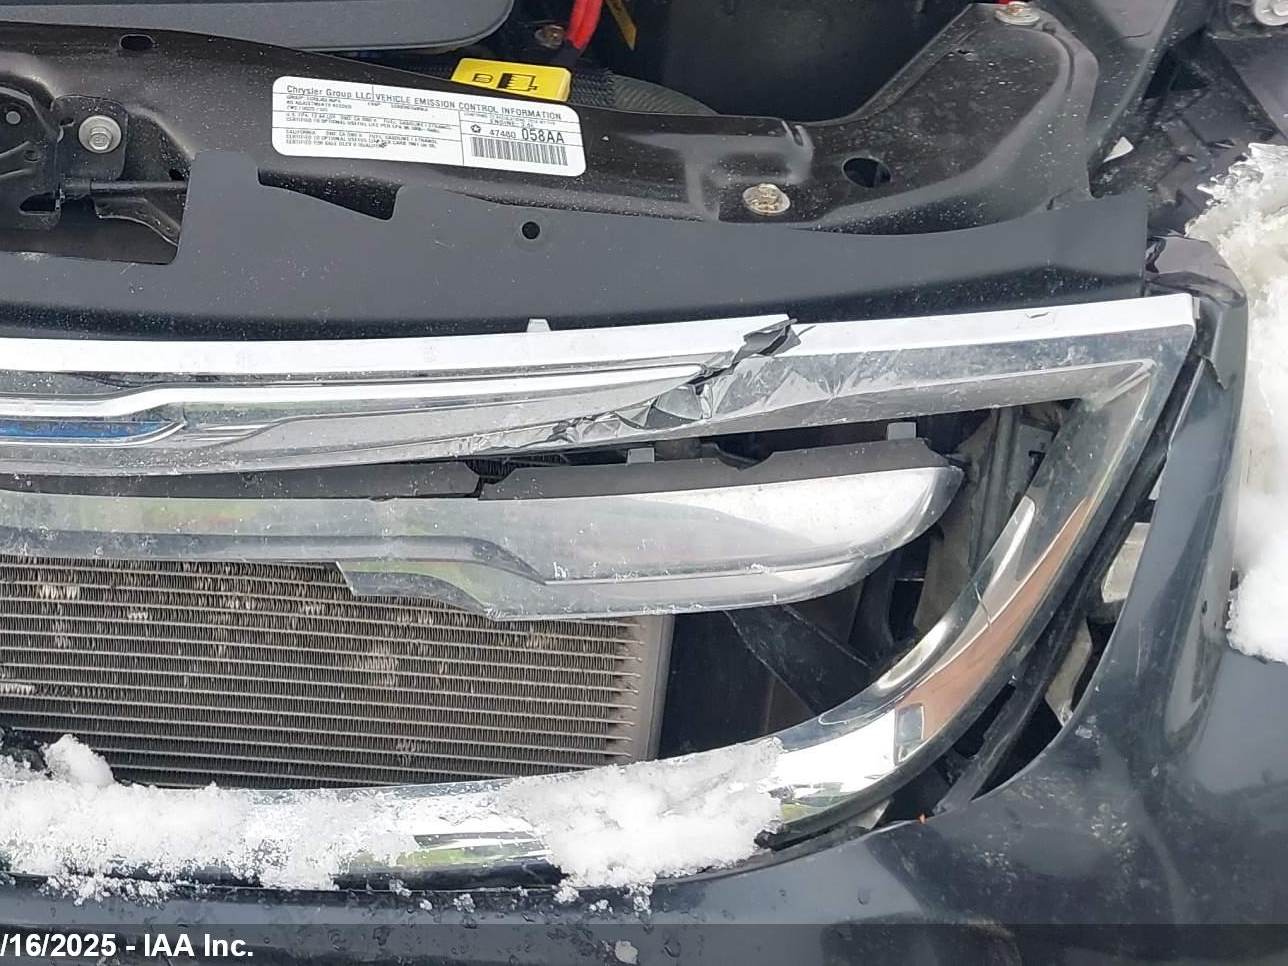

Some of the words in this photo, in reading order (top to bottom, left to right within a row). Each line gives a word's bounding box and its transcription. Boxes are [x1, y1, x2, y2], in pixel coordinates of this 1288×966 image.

[286, 85, 322, 95] Chrysler
[326, 88, 352, 98] Group
[376, 94, 411, 103] VEHICLE
[414, 98, 455, 108] EMISSION
[459, 102, 498, 113] CONTROL
[502, 106, 562, 120] INFORMATION
[522, 128, 565, 144] 058AA
